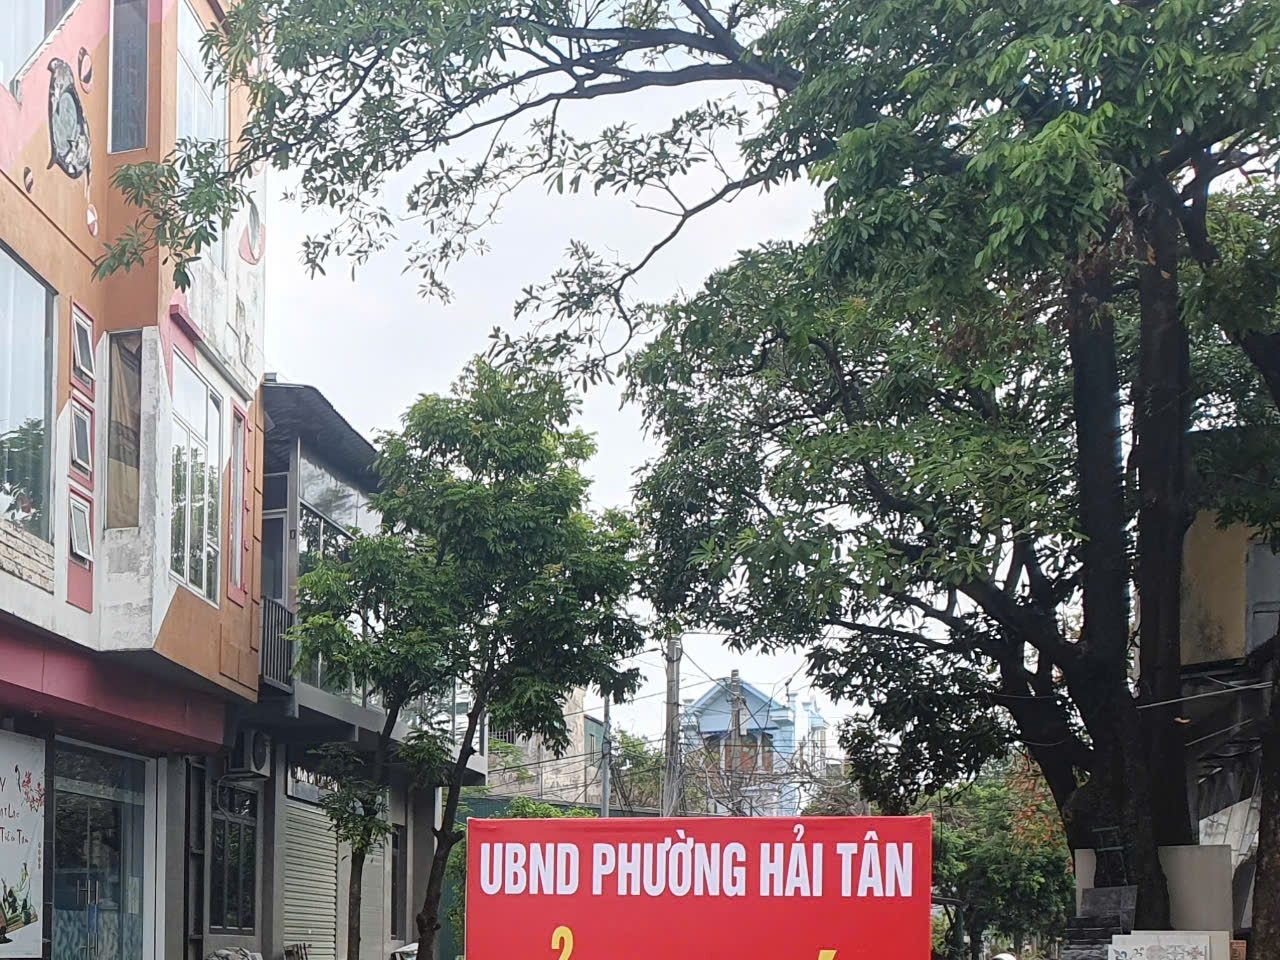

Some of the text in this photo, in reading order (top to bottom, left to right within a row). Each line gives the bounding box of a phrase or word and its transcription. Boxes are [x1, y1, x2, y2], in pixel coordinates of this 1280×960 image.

[480, 823, 913, 897] UBND PHƯỜNG HẢI TÂN
